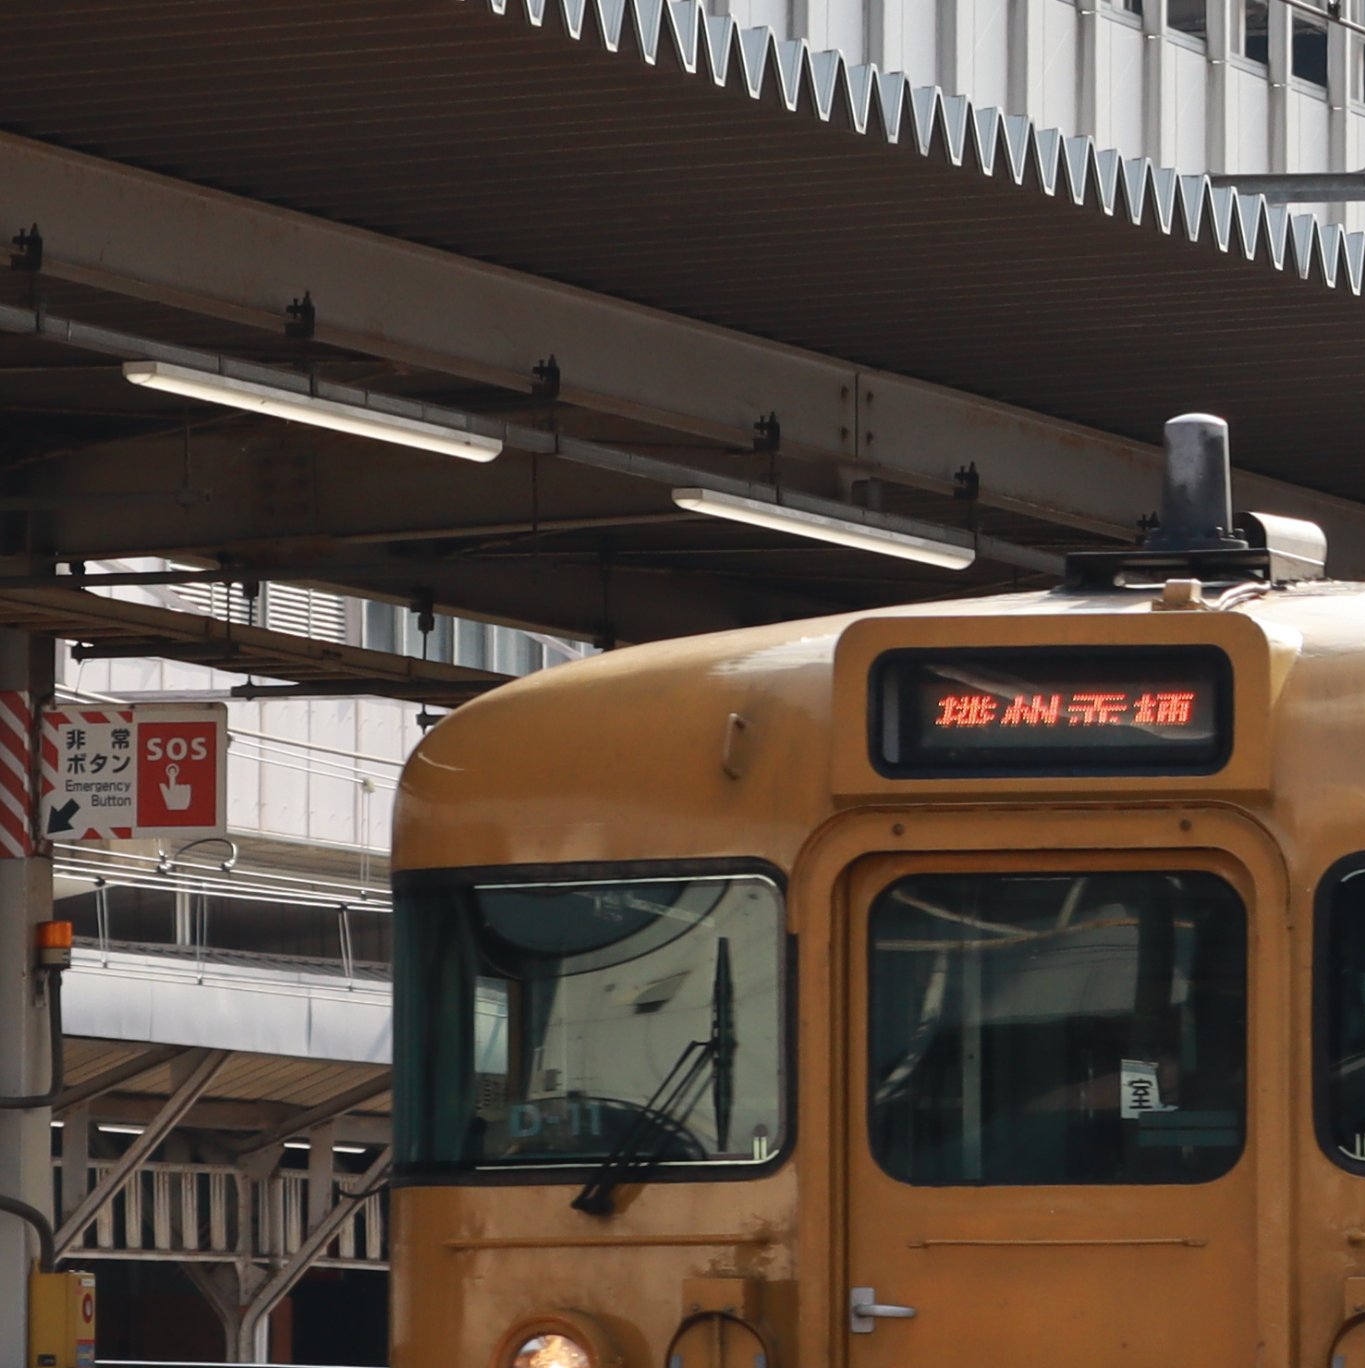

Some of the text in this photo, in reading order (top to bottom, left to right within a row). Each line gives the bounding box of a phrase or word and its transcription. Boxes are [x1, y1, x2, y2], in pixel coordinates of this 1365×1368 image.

[146, 736, 208, 762] SOS
[66, 753, 132, 775] ボタン
[64, 779, 132, 794] Emergency
[90, 793, 132, 808] Button
[1128, 1077, 1154, 1110] 室
[510, 1102, 602, 1138] D-11
